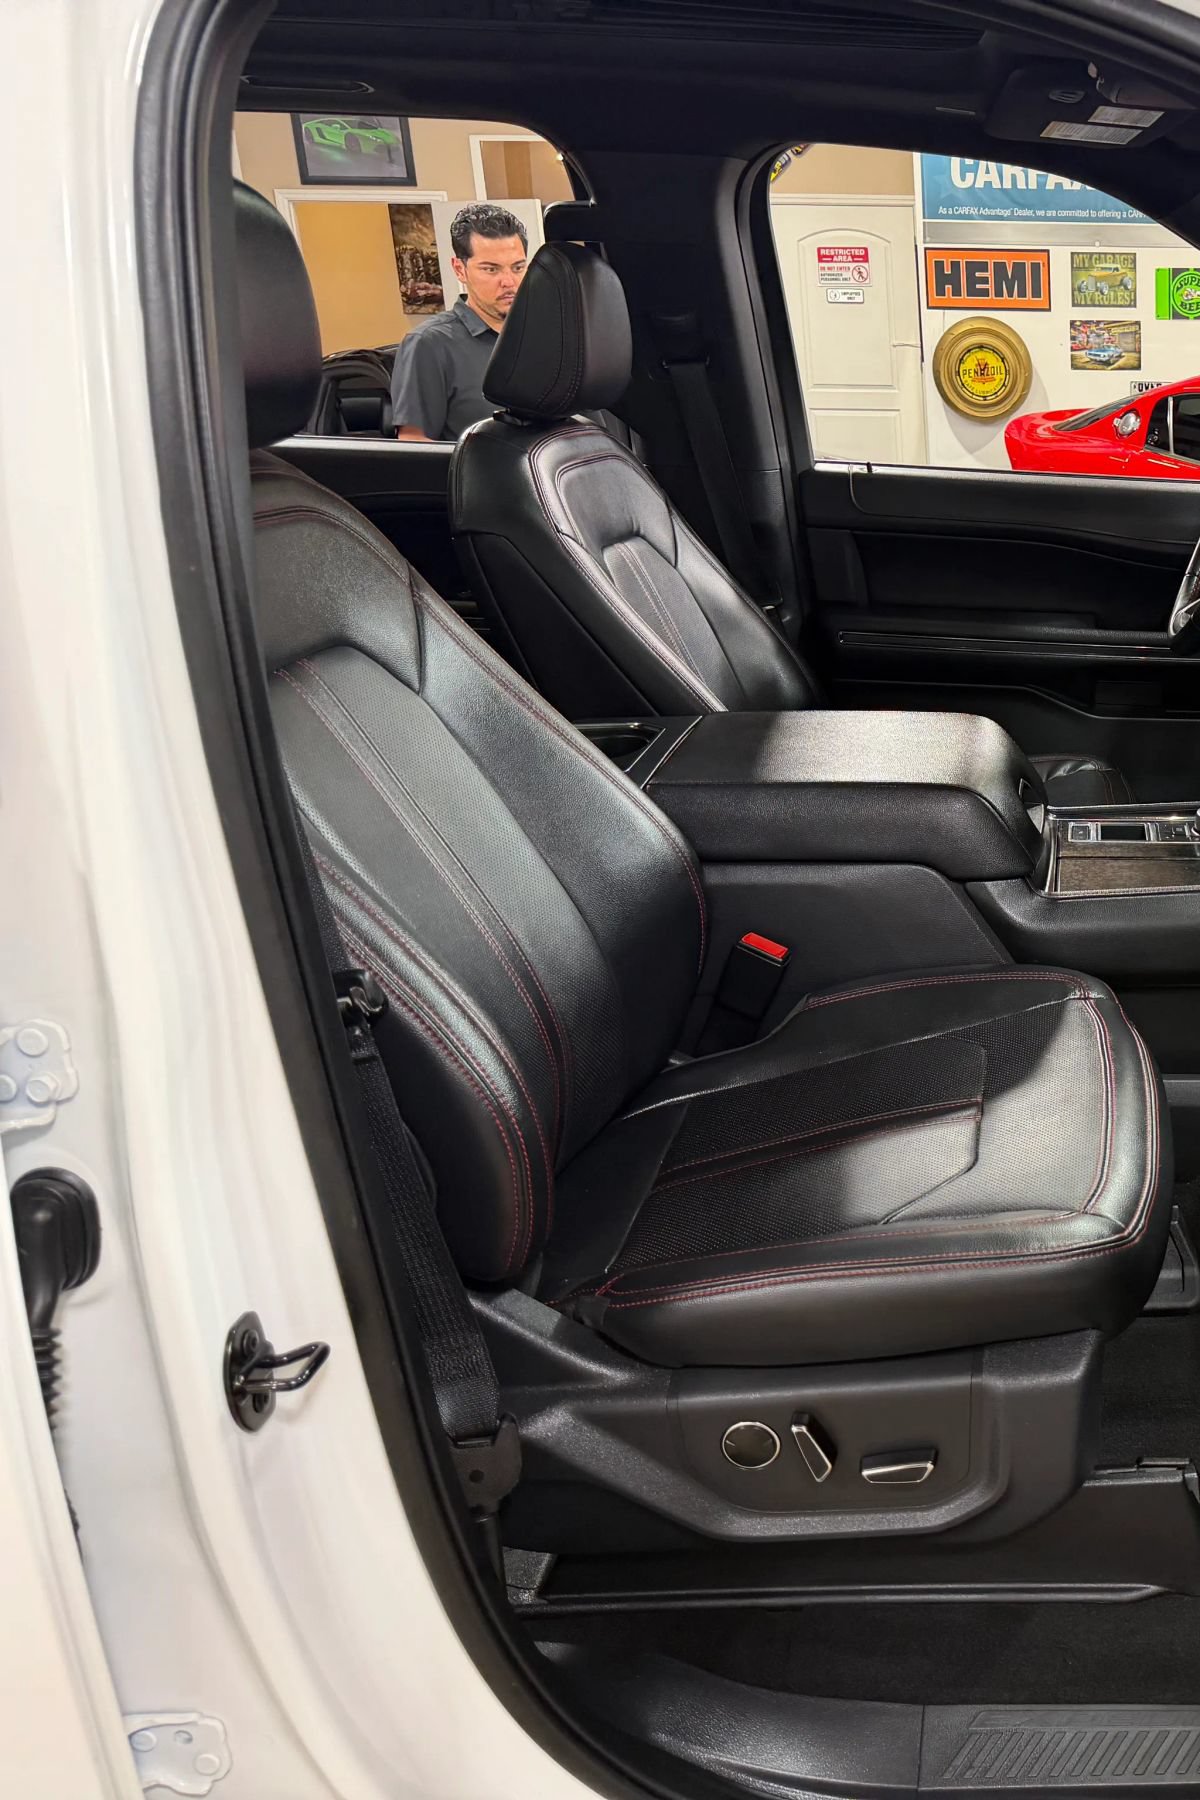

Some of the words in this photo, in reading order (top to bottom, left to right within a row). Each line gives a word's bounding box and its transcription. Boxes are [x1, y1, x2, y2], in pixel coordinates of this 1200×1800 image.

[950, 157, 1095, 190] CARF
[938, 206, 947, 215] As
[953, 206, 978, 216] CARFAX
[979, 207, 1011, 218] Advantage
[1036, 209, 1045, 217] we
[1046, 209, 1057, 217] are
[1057, 208, 1089, 218] committed
[1090, 208, 1097, 217] to
[1098, 208, 1121, 220] offering
[820, 248, 866, 256] RESTRICTED
[832, 255, 854, 263] AREA
[1073, 253, 1090, 268] MY
[1092, 254, 1135, 268] GARAGE
[933, 259, 1043, 300] HEMI
[1073, 290, 1093, 305] MY
[1094, 291, 1135, 306] RULES!
